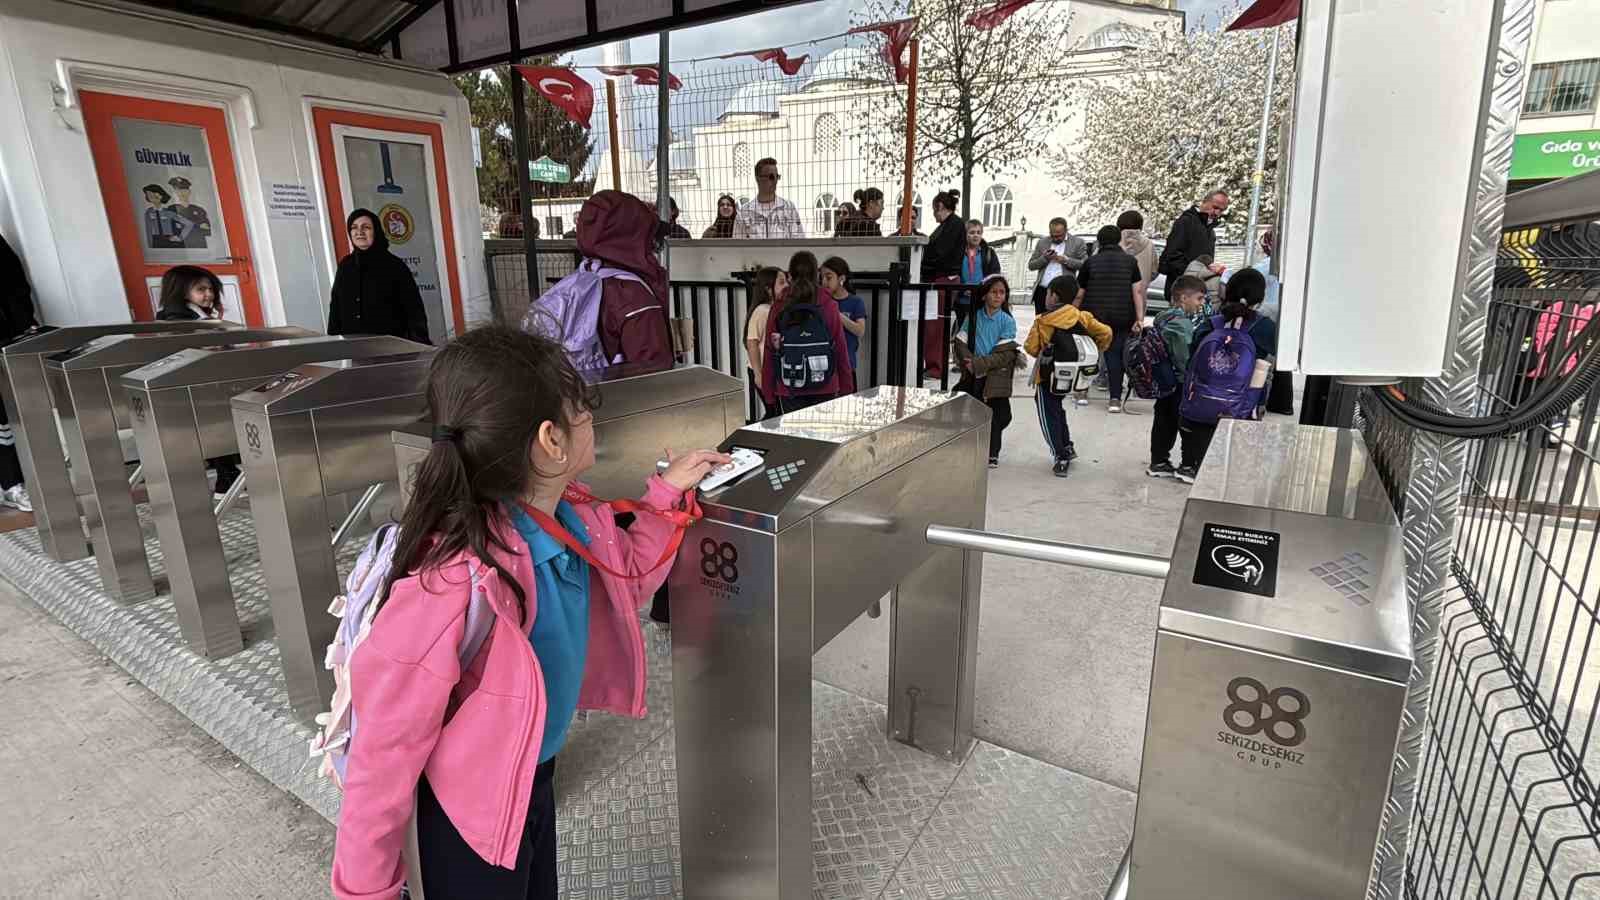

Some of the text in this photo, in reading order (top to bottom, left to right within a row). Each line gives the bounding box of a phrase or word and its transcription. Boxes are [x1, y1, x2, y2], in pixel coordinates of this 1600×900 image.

[1541, 140, 1600, 154] Gıda v
[135, 148, 192, 167] GÜVENLİK
[1236, 751, 1281, 769] GRUP
